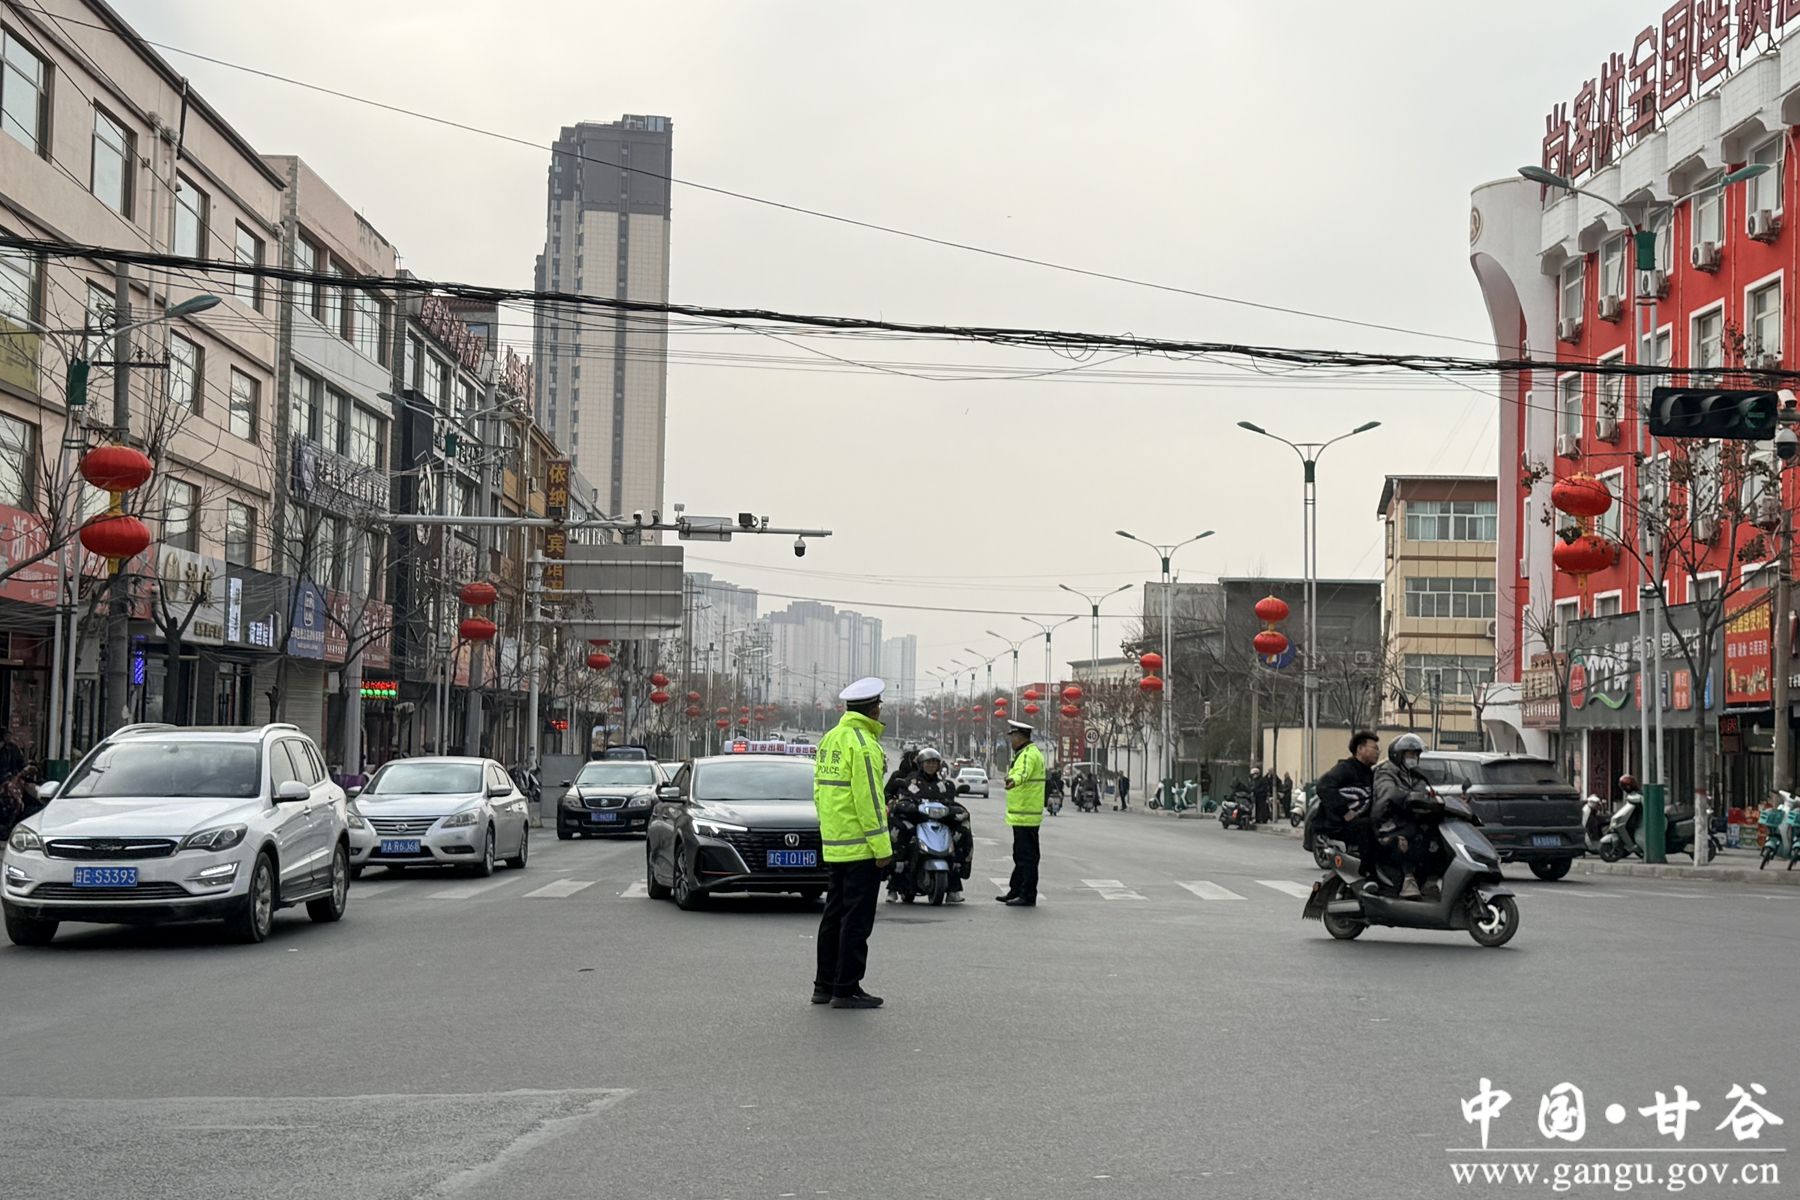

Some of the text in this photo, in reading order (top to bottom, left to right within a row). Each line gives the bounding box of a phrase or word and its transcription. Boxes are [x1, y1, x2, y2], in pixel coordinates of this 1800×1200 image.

[1541, 0, 1800, 200] 尚客优全国连锁
[1087, 730, 1097, 739] 40
[752, 743, 784, 753] 甘谷出租
